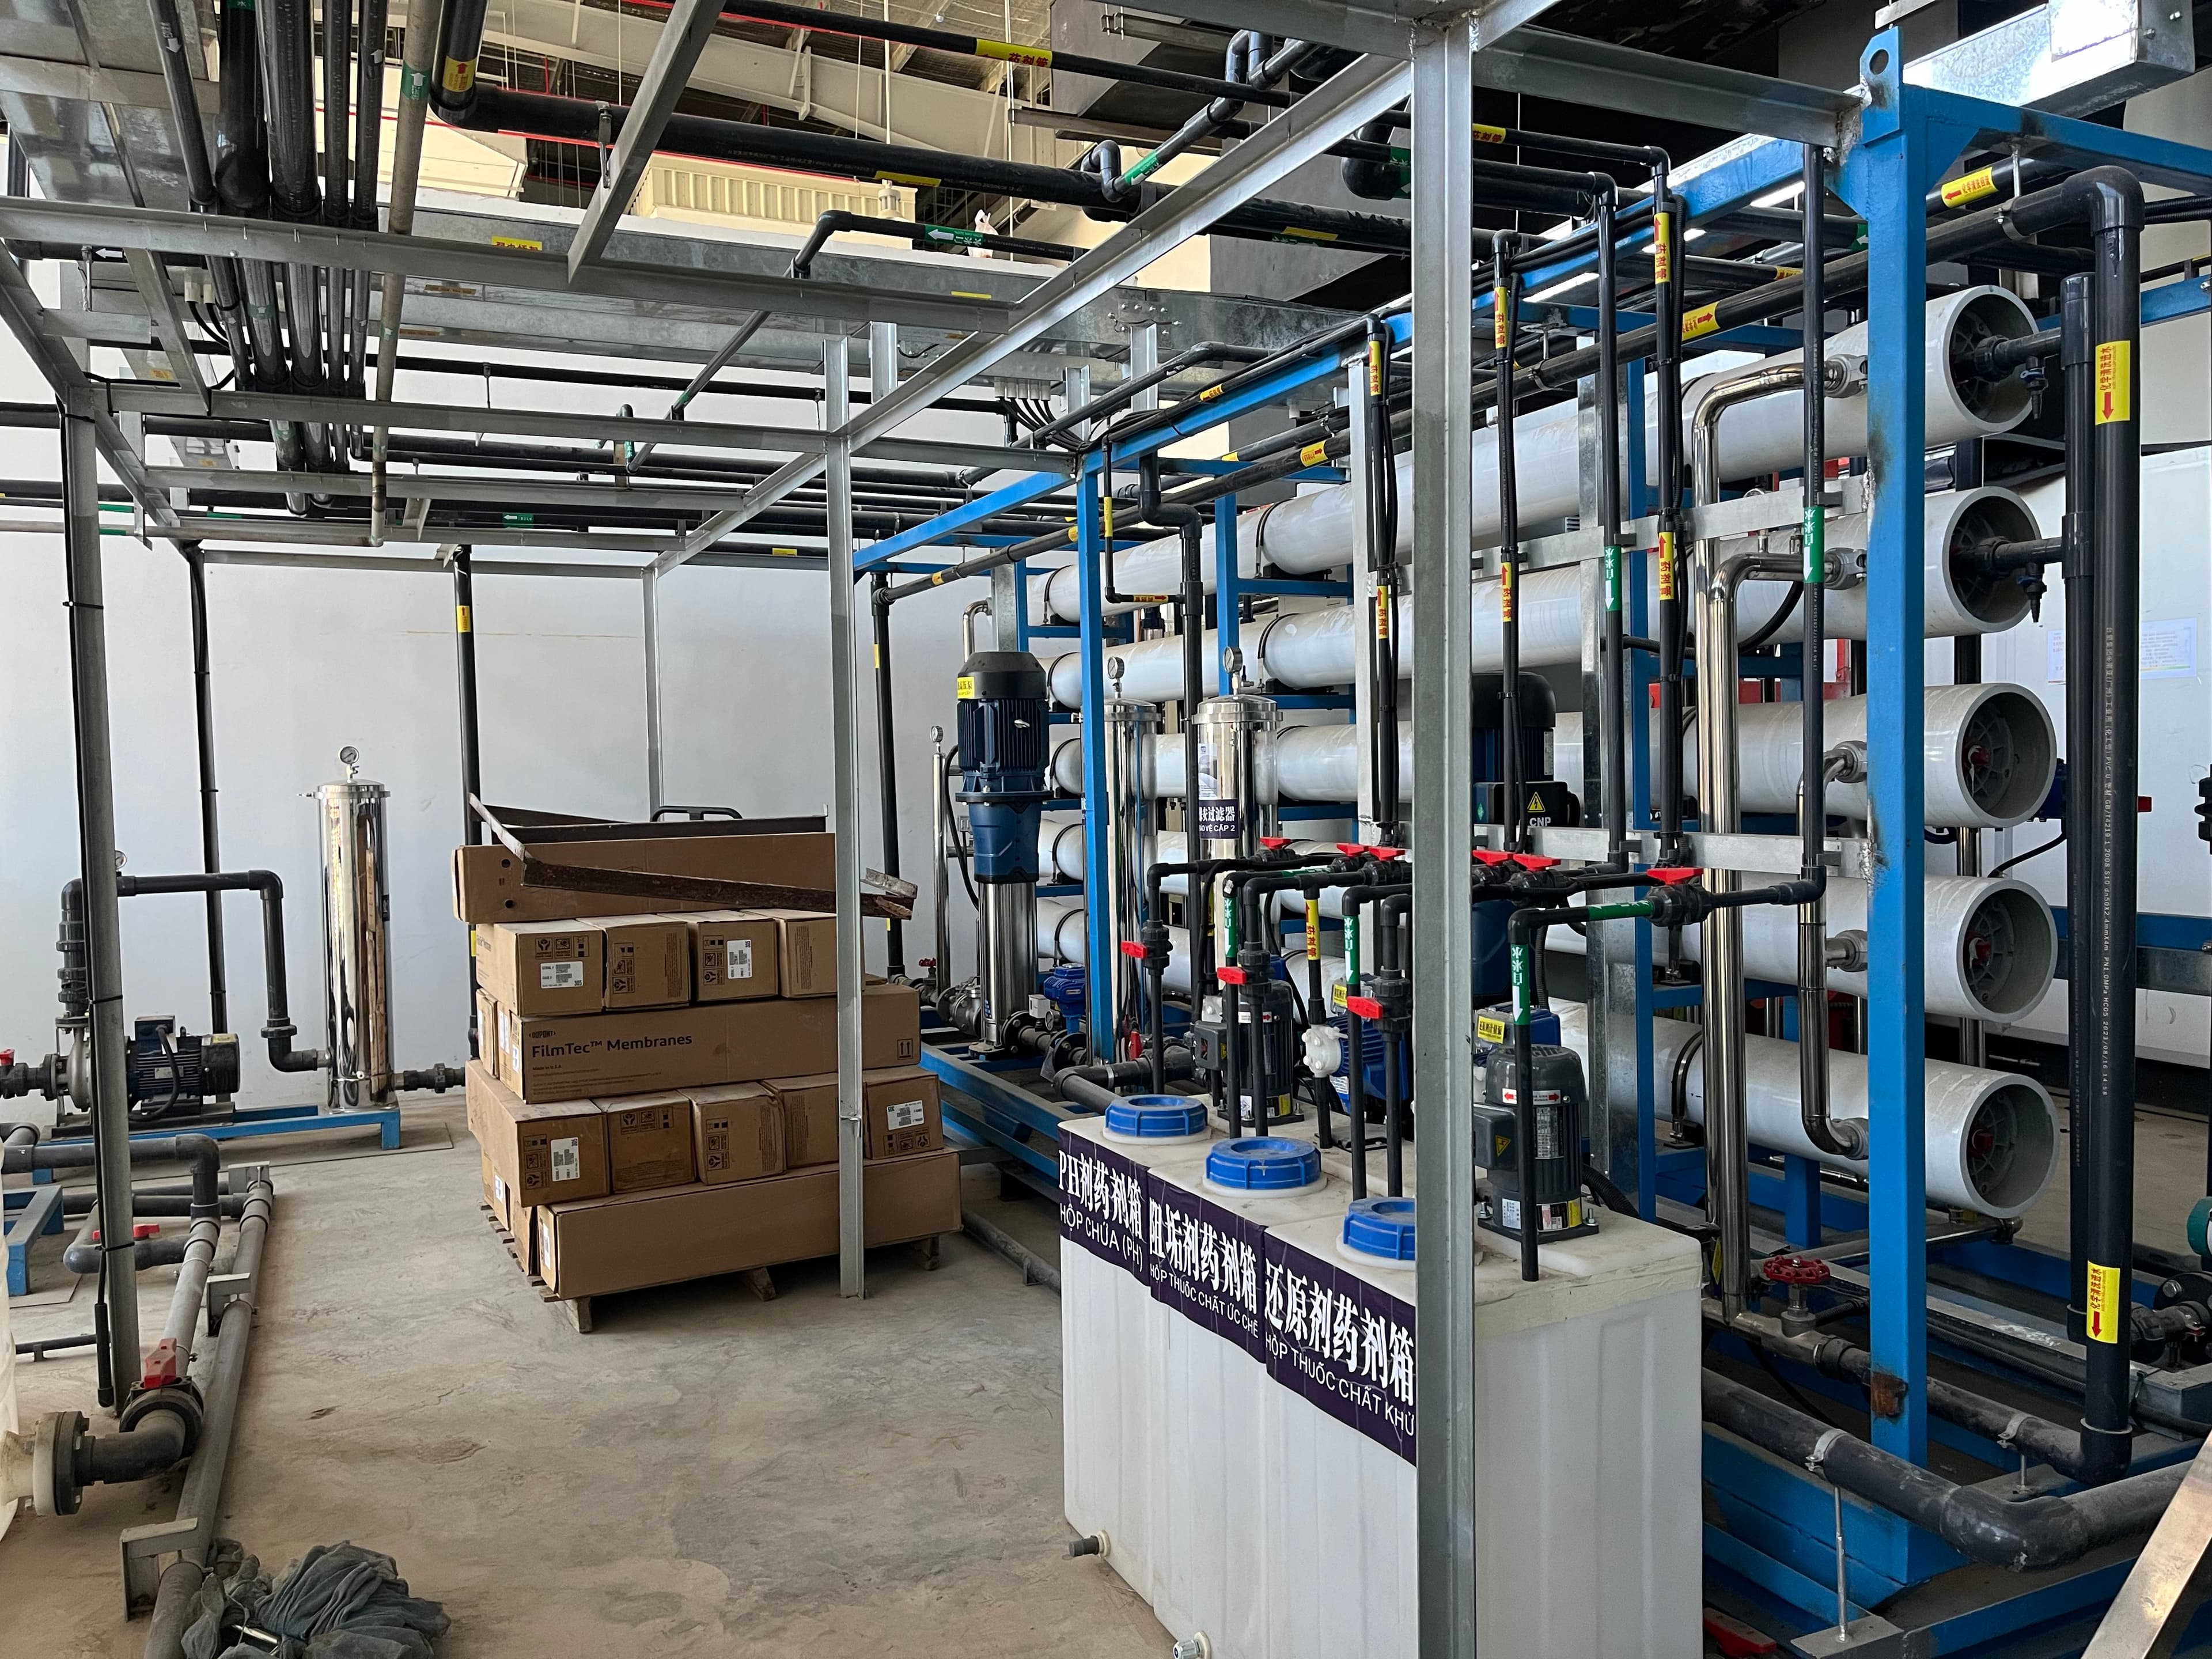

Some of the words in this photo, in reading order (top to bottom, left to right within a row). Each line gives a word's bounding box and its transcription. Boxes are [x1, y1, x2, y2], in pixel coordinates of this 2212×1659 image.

[1654, 243, 1667, 280] 药剂管
[1496, 312, 1505, 345] 药剂管
[1370, 363, 1379, 393] 药剂管
[1804, 509, 1816, 546] 自来水
[1605, 547, 1615, 579] 自来水
[1661, 560, 1672, 597] 药剂管
[1377, 607, 1387, 637] 药剂管
[1529, 816, 1552, 827] CNP
[1306, 925, 1317, 957] 药剂管
[1343, 917, 1354, 951] 自来水
[1512, 946, 1524, 985] 自来水
[532, 1031, 554, 1039] DUPONT
[607, 1034, 692, 1052] Membranes
[1059, 1203, 1083, 1232] HỘP
[1085, 1216, 1120, 1252] CHỨA
[1123, 1234, 1143, 1272] (PH)
[1149, 1197, 1257, 1315] 阻垢剂药剂箱
[1150, 1263, 1168, 1284] HỘP
[2090, 1267, 2103, 1309] 化学清洗进水
[1266, 1257, 1414, 1406] 还原剂药剂箱
[1266, 1331, 1288, 1359] HỘP
